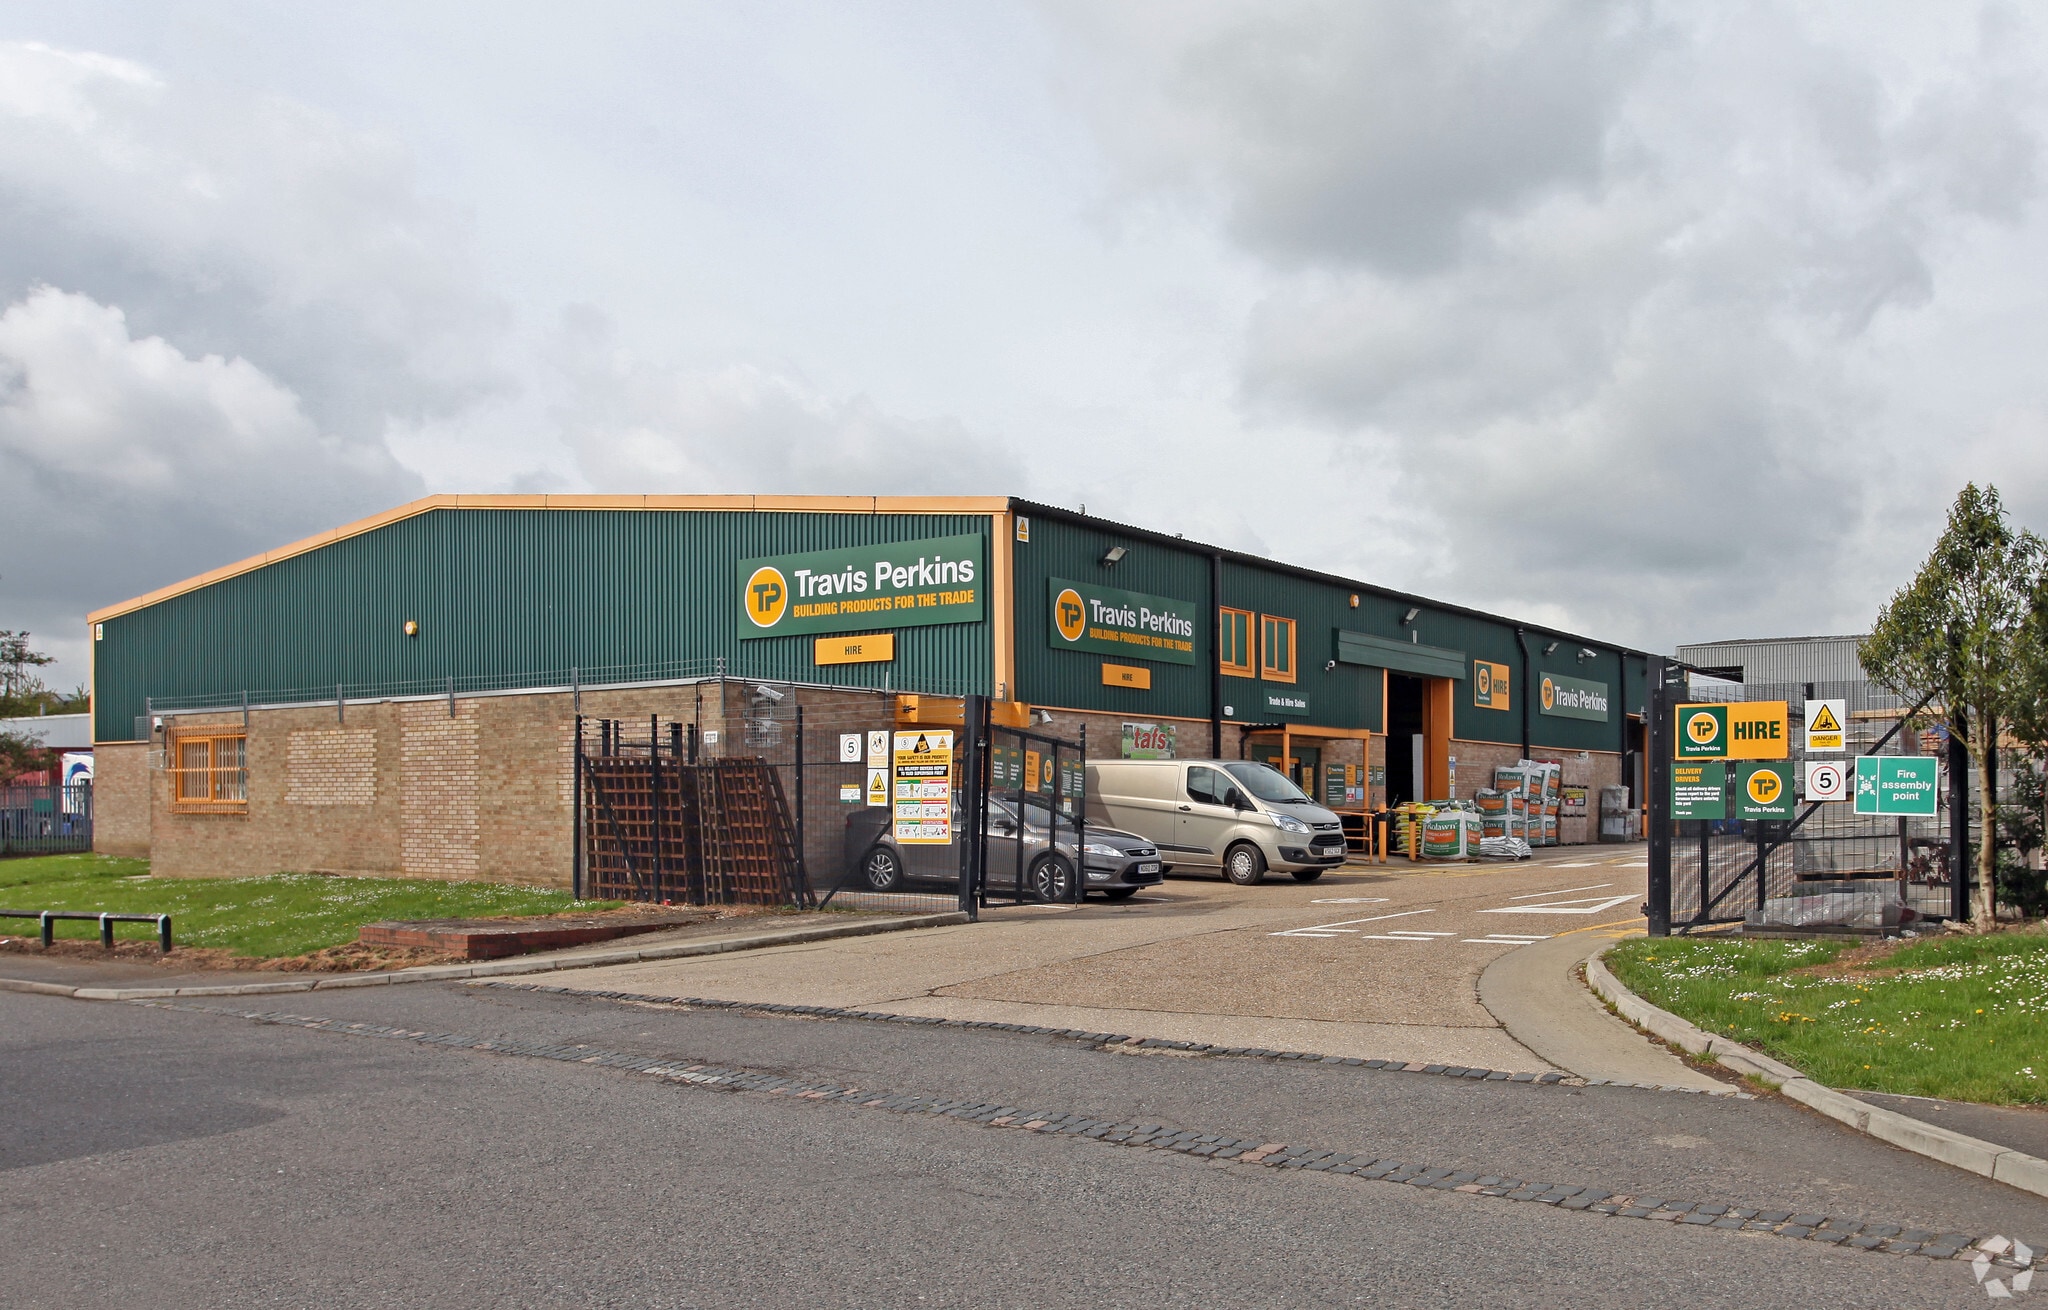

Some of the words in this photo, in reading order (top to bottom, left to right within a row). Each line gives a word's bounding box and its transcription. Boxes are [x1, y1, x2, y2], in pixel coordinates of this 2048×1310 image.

[794, 565, 868, 598] Travis
[875, 556, 975, 590] Perkins
[752, 582, 781, 612] TP
[794, 602, 838, 618] BUILDING
[840, 597, 892, 614] PRODUCTS
[894, 594, 915, 608] FOR
[917, 592, 937, 607] THE
[938, 590, 974, 605] TRADE
[1061, 602, 1081, 628] TP
[1090, 599, 1136, 628] Travis
[1140, 607, 1192, 636] Perkins
[1090, 628, 1119, 642] BUILDING
[1120, 630, 1150, 646] PRODUCTS
[1151, 636, 1162, 648] FOR
[1163, 638, 1174, 650] THE
[1175, 640, 1192, 652] TRADE
[844, 645, 862, 656] HIRE
[1122, 673, 1133, 682] HIRE
[1493, 678, 1507, 695] HIRE
[1269, 696, 1280, 706] Trade
[1281, 698, 1285, 706] &
[1285, 698, 1294, 707] Hire
[1294, 699, 1306, 708] Sales
[1554, 686, 1578, 708] Travis
[1580, 690, 1607, 712] Perkins
[1694, 722, 1714, 736] TP
[1734, 721, 1780, 740] HIRE
[1134, 727, 1166, 750] tafs
[848, 742, 854, 753] 5
[1820, 772, 1832, 789] 5
[1897, 770, 1916, 778] Fire
[1754, 779, 1776, 795] TP
[1882, 781, 1932, 791] assembly
[1893, 792, 1920, 801] point
